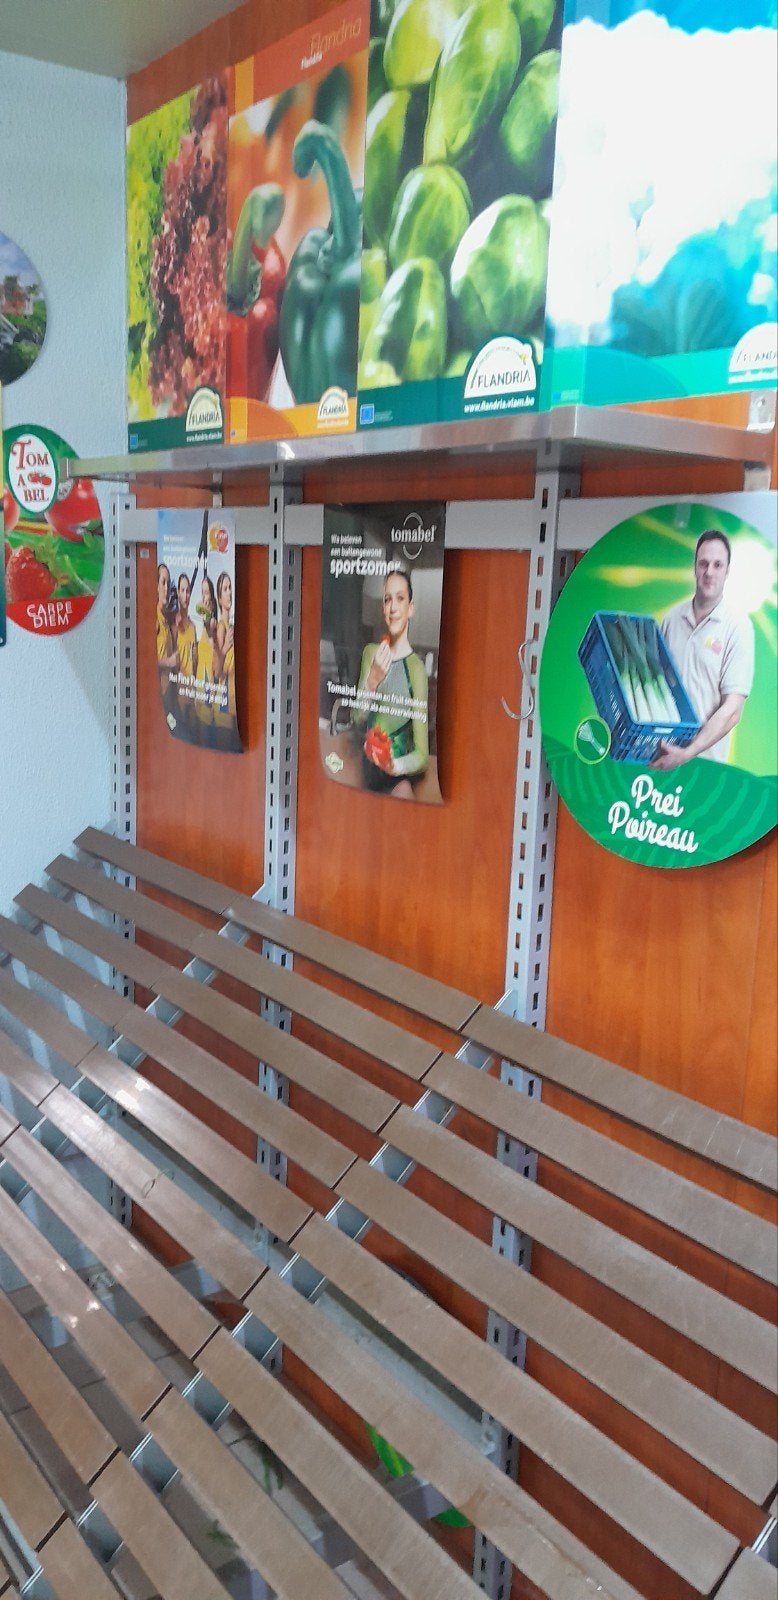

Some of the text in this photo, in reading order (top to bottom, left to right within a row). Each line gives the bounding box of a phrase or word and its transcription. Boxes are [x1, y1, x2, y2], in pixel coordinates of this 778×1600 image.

[477, 369, 531, 389] FLANDRIA
[191, 411, 220, 426] FLANDRIA
[17, 474, 26, 486] A
[24, 489, 50, 502] BEL
[391, 525, 436, 543] tomabel
[26, 601, 73, 618] CARPE
[33, 613, 69, 628] DIEM
[327, 680, 356, 697] Tomabel
[631, 774, 684, 817] Prei
[608, 801, 698, 853] Poireau
